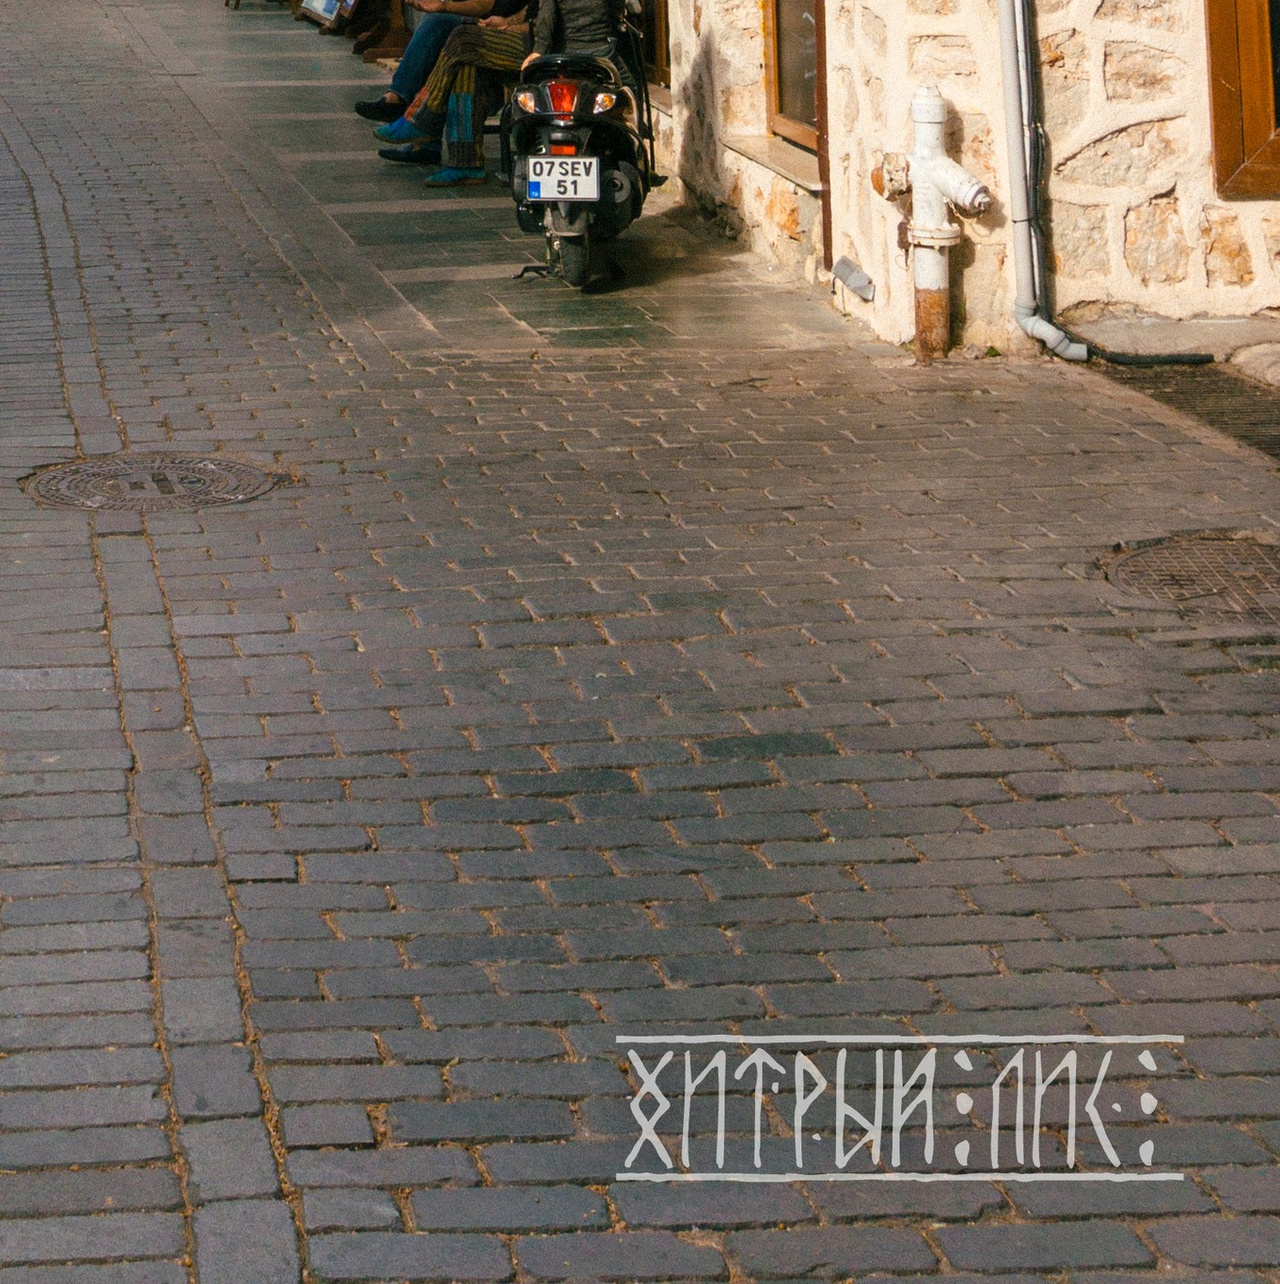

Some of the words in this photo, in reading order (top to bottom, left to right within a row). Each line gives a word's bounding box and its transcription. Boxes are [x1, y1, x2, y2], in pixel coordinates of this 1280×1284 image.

[532, 160, 556, 177] 07
[558, 160, 593, 177] SEV
[556, 179, 578, 195] 51
